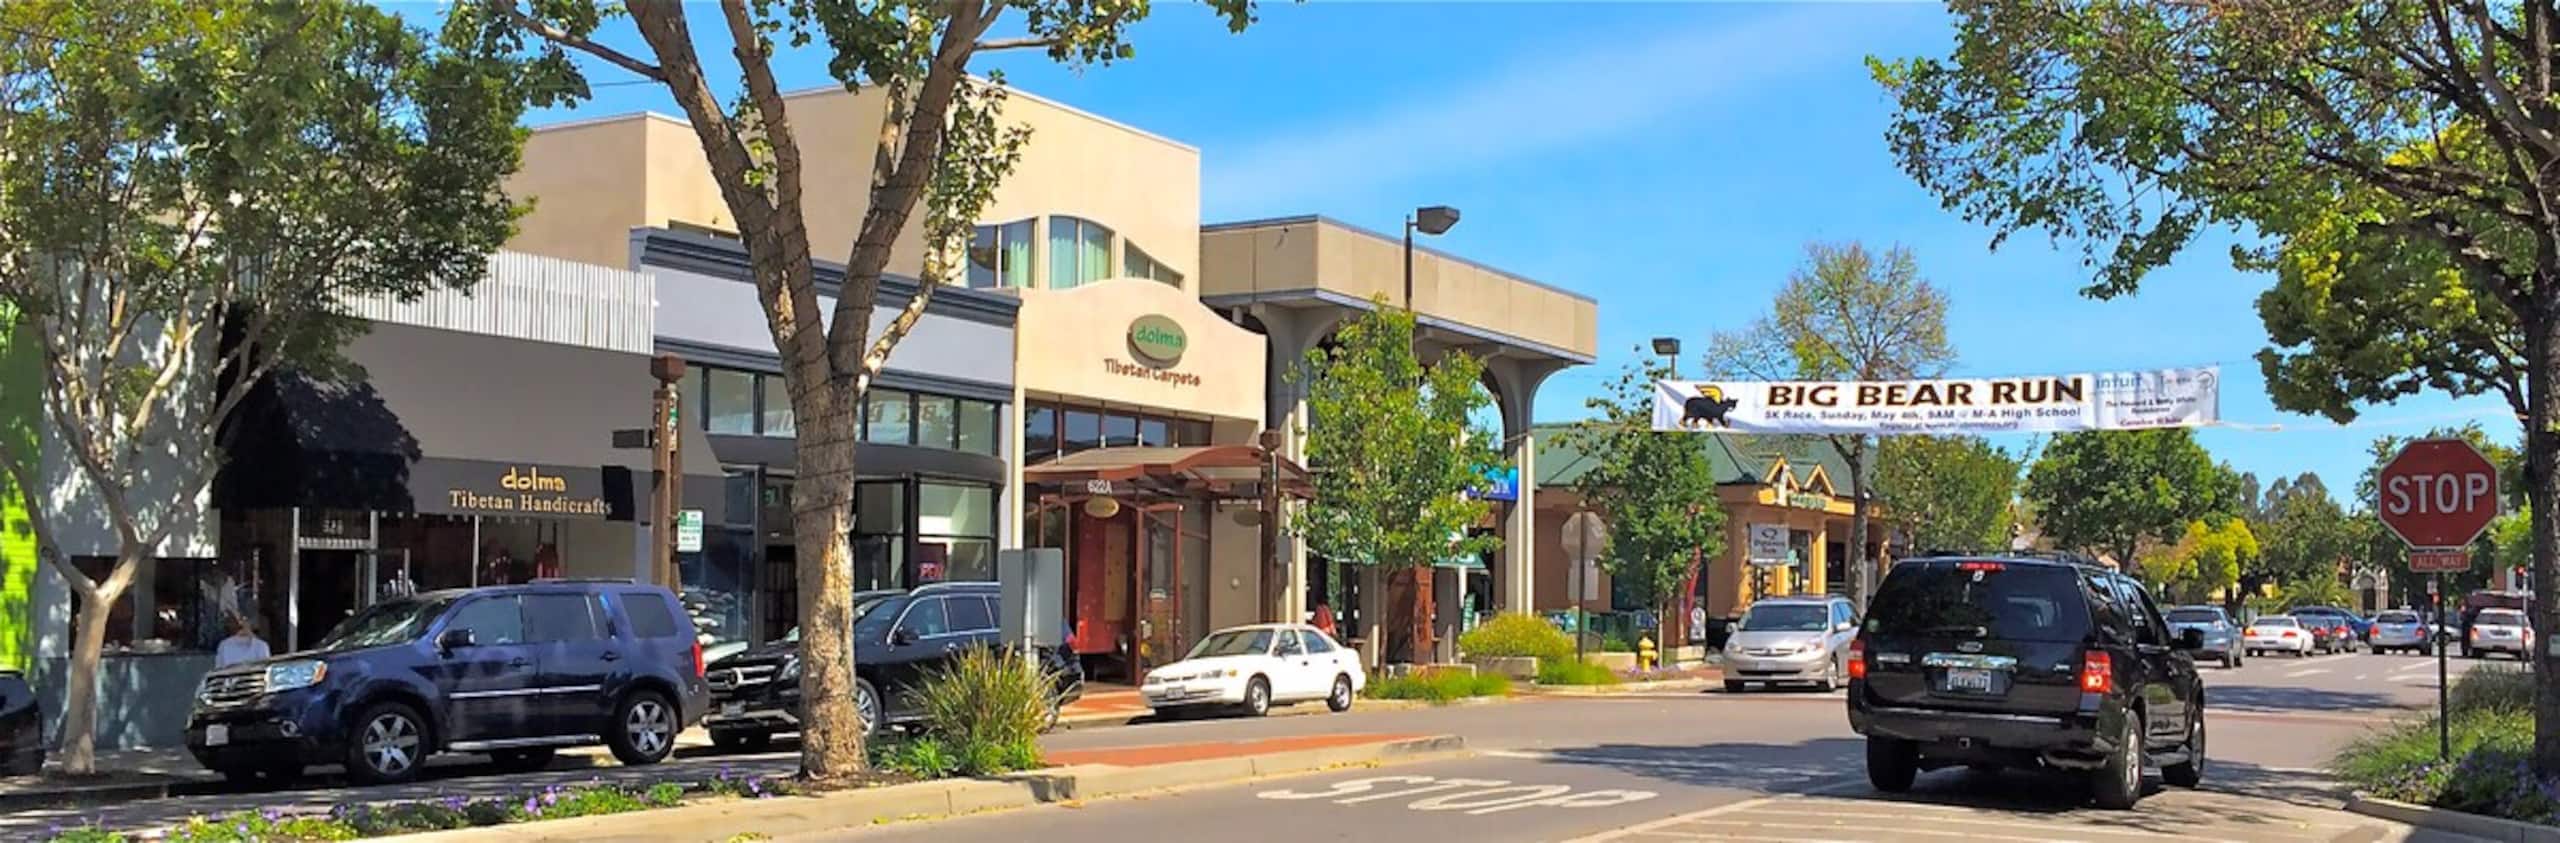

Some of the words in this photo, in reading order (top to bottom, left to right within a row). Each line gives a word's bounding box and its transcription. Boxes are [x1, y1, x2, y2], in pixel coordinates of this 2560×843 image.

[1136, 326, 1183, 347] dolma
[1104, 358, 1150, 379] Tibetan
[1152, 370, 1201, 389] Carpets
[1768, 386, 1838, 406] BIG
[1857, 382, 1974, 406] BEAR
[1991, 378, 2083, 403] RUN
[1821, 410, 1867, 421] Sunday,
[1871, 410, 1895, 421] May
[2001, 408, 2031, 419] High
[2037, 407, 2081, 417] School
[501, 466, 566, 491] dolma
[450, 490, 513, 510] Tibetan
[520, 494, 612, 515] Handicrafts
[2388, 473, 2489, 515] STOP
[2416, 556, 2435, 567] ALL
[2441, 555, 2464, 566] WAY
[1256, 775, 1660, 815] STOP
